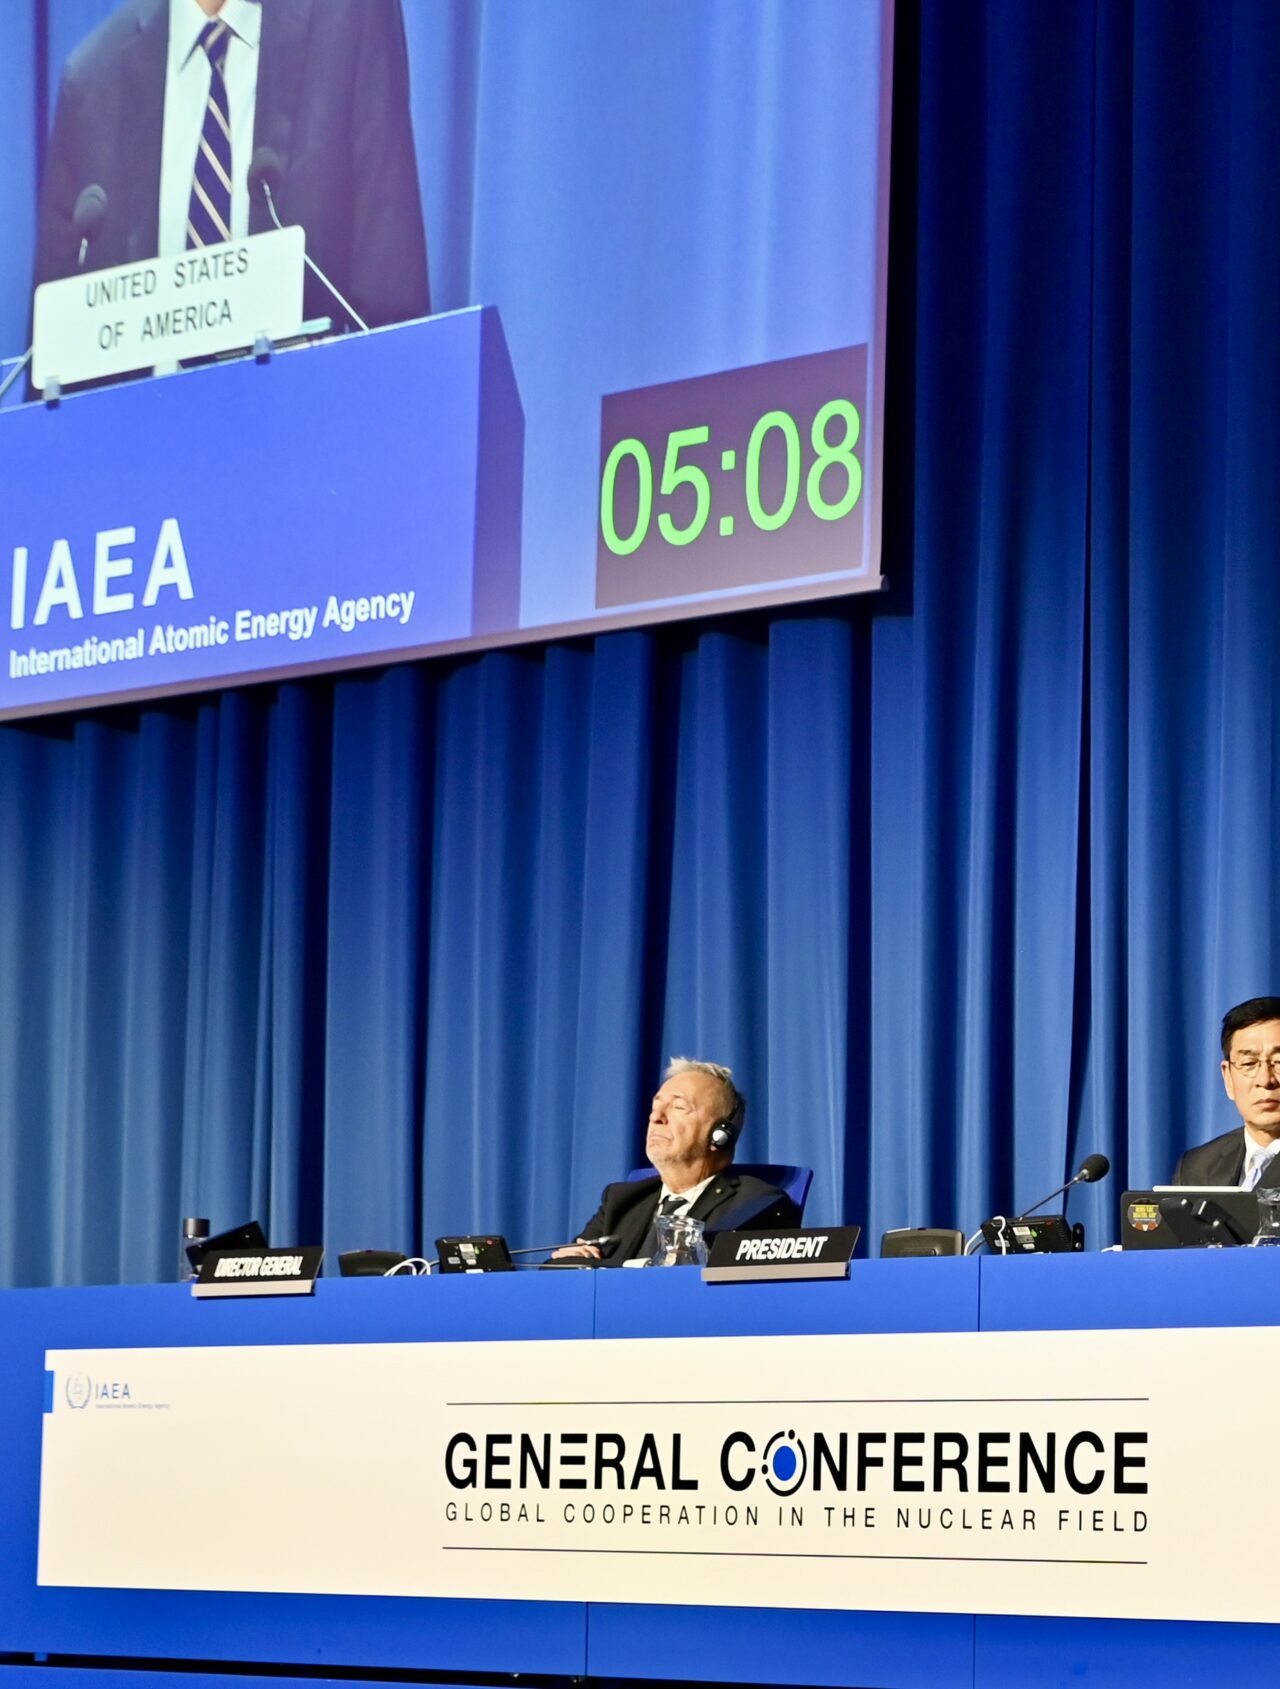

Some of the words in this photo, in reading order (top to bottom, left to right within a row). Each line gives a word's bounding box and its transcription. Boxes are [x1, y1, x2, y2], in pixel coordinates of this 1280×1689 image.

[86, 269, 157, 308] UNITED
[174, 248, 249, 288] STATES
[99, 322, 124, 350] OF
[140, 298, 233, 342] AMERICA
[600, 399, 863, 556] 05:08
[10, 517, 195, 630] IAEA
[9, 628, 144, 679] International
[148, 616, 229, 655] Atomic
[235, 607, 318, 641] Energy
[322, 591, 415, 632] Agency
[736, 1236, 828, 1260] PRESIDENT
[95, 1383, 131, 1399] IAEA
[445, 1432, 698, 1490] GENERAL
[720, 1429, 1148, 1497] CONFERENCE
[446, 1502, 545, 1522] GLOBAL
[564, 1504, 757, 1525] COOPERATION
[779, 1507, 802, 1526] IN
[824, 1507, 875, 1527] THE
[897, 1508, 1035, 1530] NUCLEAR
[1059, 1510, 1147, 1532] FIELD
